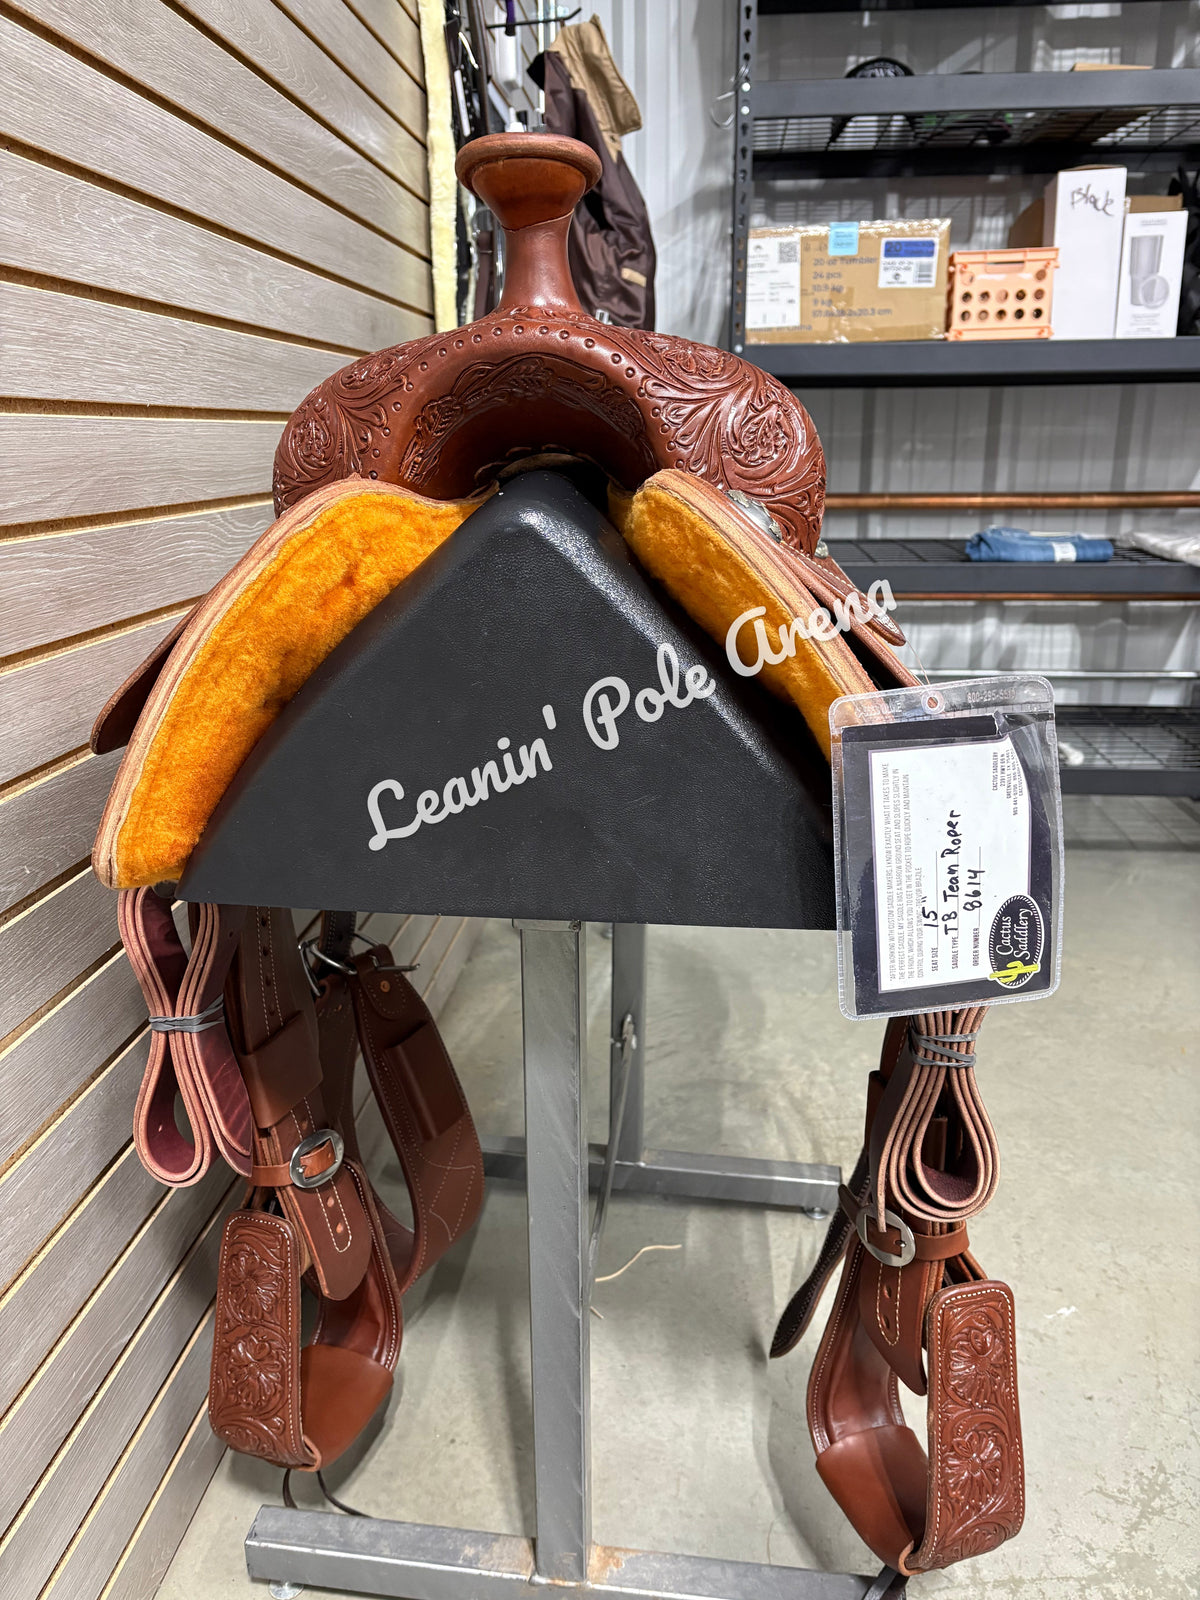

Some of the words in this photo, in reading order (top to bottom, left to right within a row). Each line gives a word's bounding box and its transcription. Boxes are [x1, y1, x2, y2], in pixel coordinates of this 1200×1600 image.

[812, 258, 825, 266] 20
[839, 256, 878, 265] Tumbler
[812, 272, 825, 280] 24
[891, 774, 899, 798] SLIGHTLY
[901, 774, 909, 798] MAINTAIN
[892, 799, 900, 818] SLOPES
[902, 811, 910, 832] QUICKLY
[893, 831, 901, 844] SEAT
[939, 809, 962, 858] Roper
[904, 874, 912, 882] THE
[914, 867, 922, 887] BRAZILE
[941, 863, 960, 902] Team
[895, 891, 903, 902] HAS
[962, 869, 985, 911] 8614
[905, 906, 913, 916] YOU
[921, 895, 938, 928] 15"
[972, 927, 980, 948] NUMBER
[995, 916, 1013, 955] Cactus
[1014, 908, 1032, 960] Saddlery
[906, 937, 914, 953] WHICH
[897, 950, 905, 970] PERFECT
[916, 958, 924, 978] CONTROL
